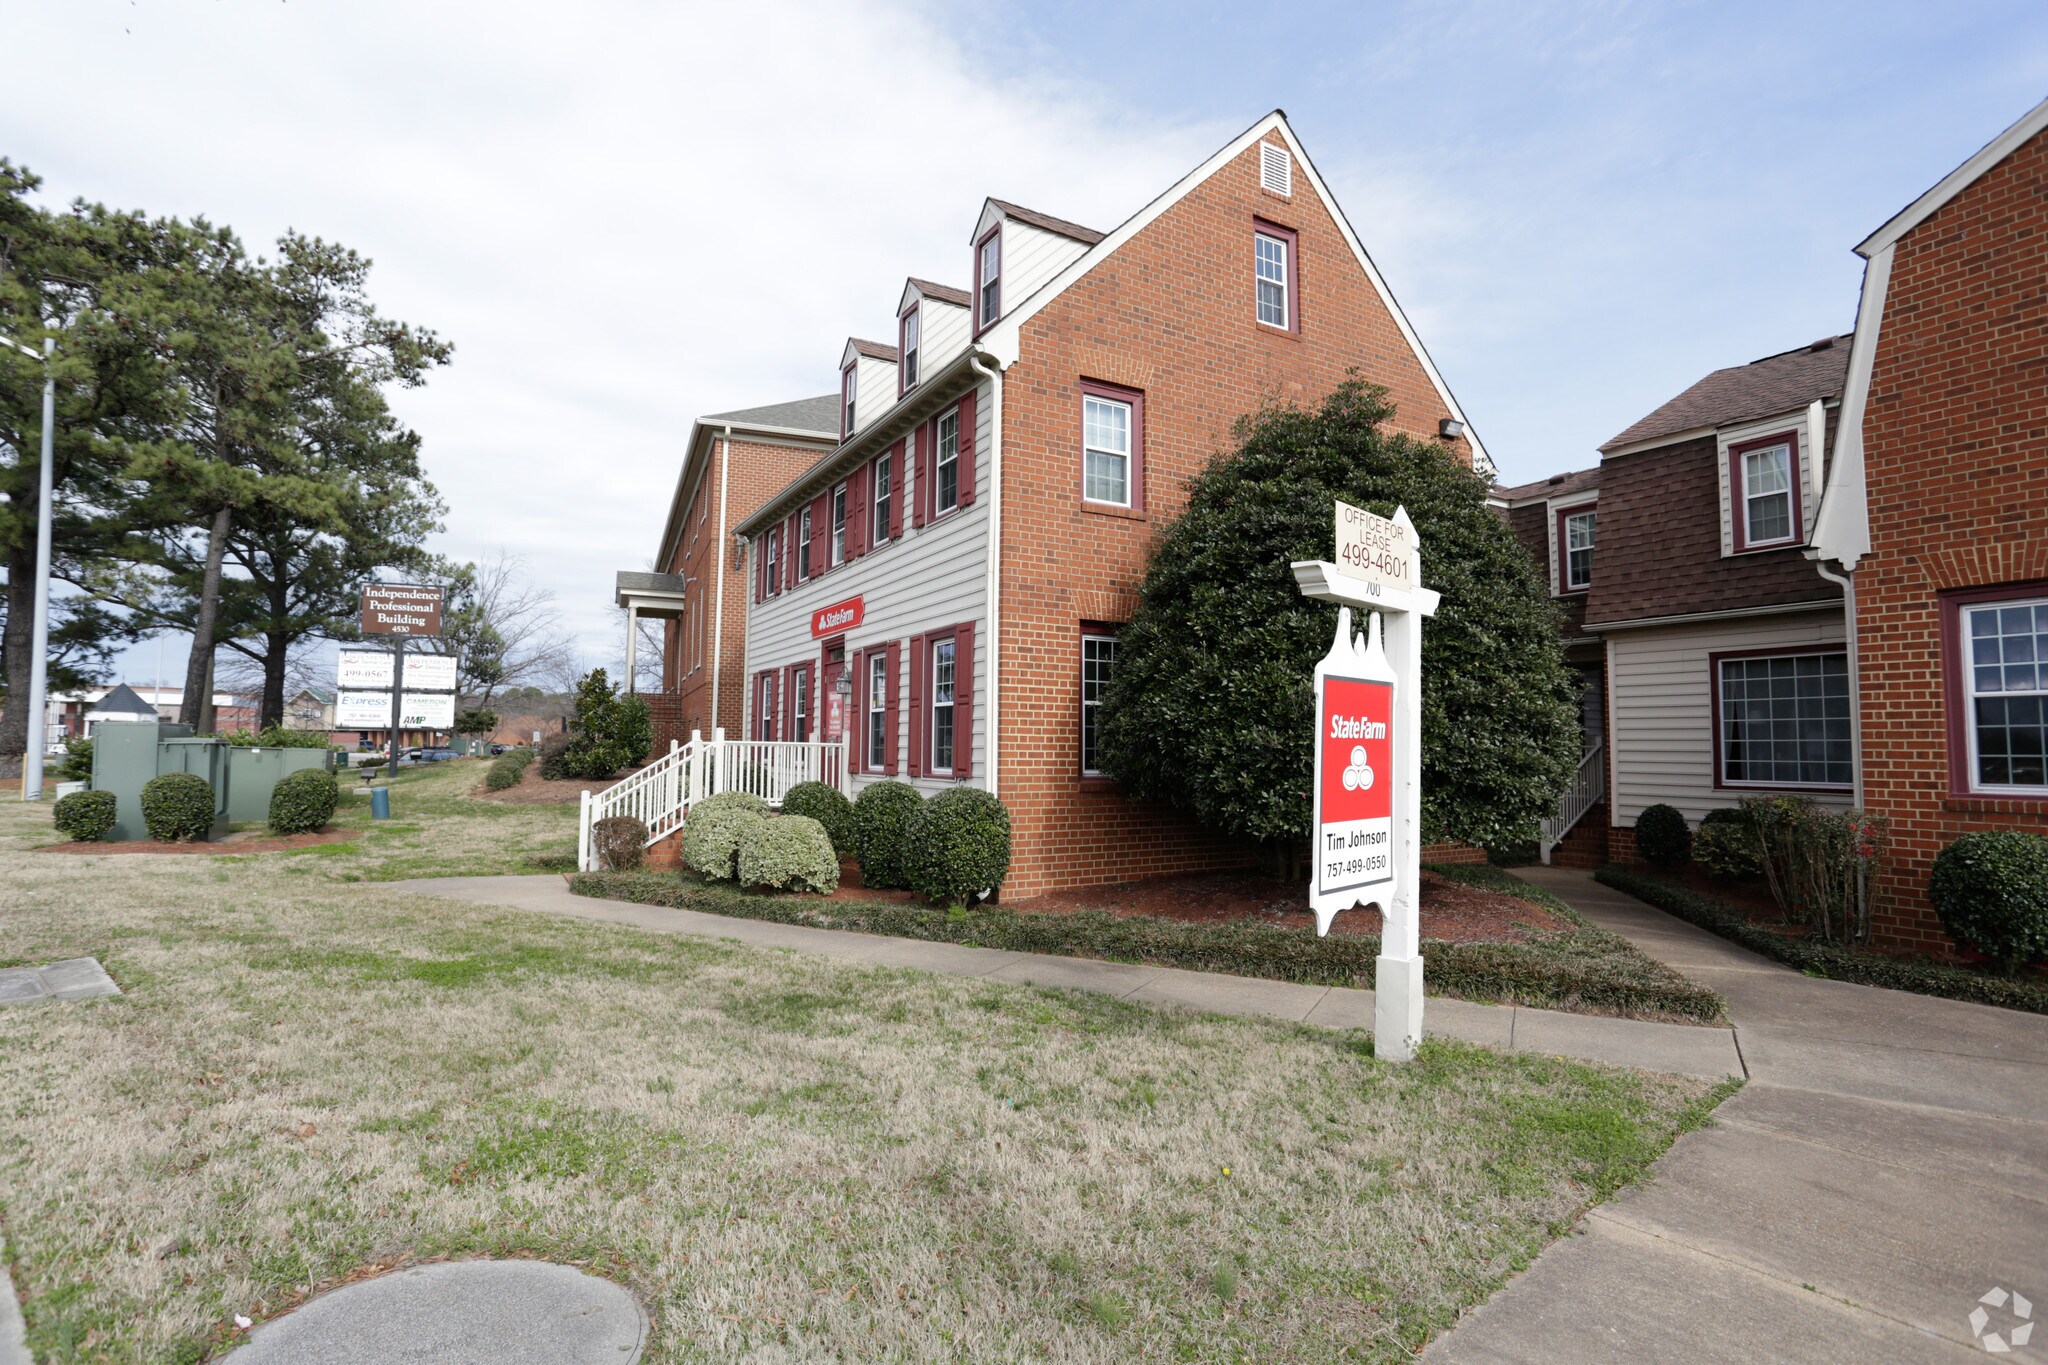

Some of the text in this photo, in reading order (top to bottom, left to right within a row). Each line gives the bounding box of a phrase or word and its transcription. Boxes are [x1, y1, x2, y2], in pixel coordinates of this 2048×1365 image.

[1344, 507, 1404, 542] OFFICE FOR
[1359, 529, 1391, 553] LEASE
[1342, 542, 1408, 580] 499-4601
[365, 586, 440, 600] Independence
[369, 600, 434, 612] Professional
[377, 612, 426, 627] Building
[391, 625, 410, 633] 4530
[343, 669, 388, 678] 499-0567
[341, 696, 388, 706] Express
[1326, 830, 1387, 852] Tim Johnson
[1326, 854, 1387, 878] 757-499-0550
